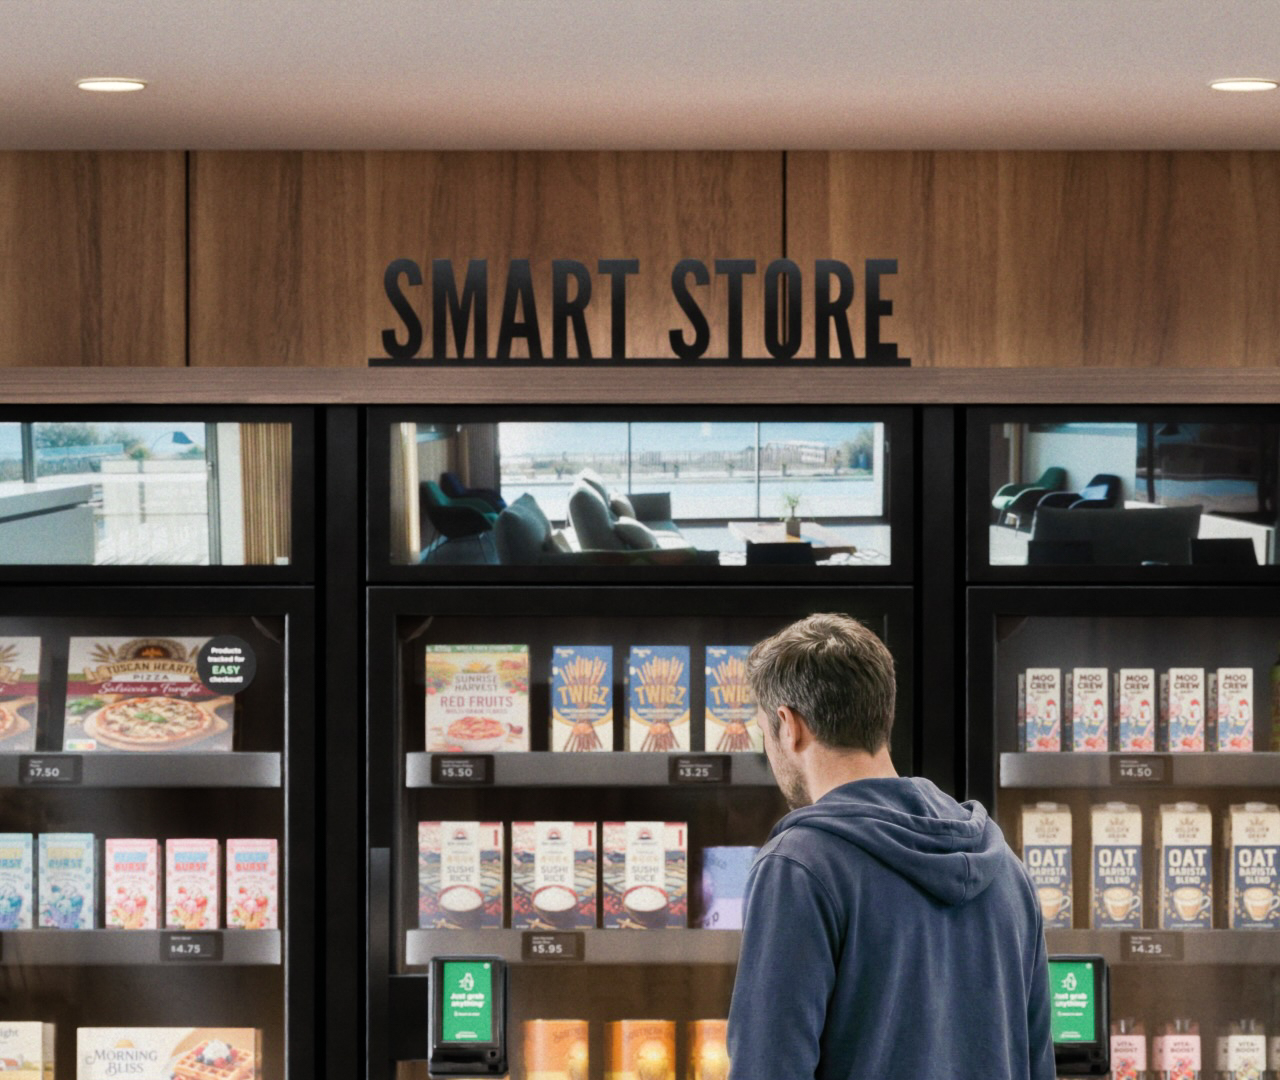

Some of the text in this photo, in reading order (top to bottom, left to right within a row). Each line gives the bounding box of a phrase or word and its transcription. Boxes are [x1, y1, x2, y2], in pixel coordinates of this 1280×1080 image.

[381, 258, 899, 360] SMART STORE
[106, 661, 151, 675] TUSCAN
[211, 665, 241, 675] EASY
[132, 673, 169, 681] PIZZA
[1032, 674, 1054, 682] MOO
[1079, 674, 1101, 682] MOO
[1126, 675, 1148, 683] MOO
[1176, 674, 1198, 682] MOO
[1224, 674, 1246, 682] MOO
[558, 685, 610, 705] TWIGZ
[634, 685, 687, 705] TWIGZ
[710, 685, 751, 705] TWIG
[440, 695, 513, 708] RED FRUITS
[30, 767, 60, 777] $7.50
[442, 767, 473, 777] $5.50
[679, 767, 709, 777] $3.25
[1120, 767, 1152, 777] $4.50
[1028, 848, 1068, 867] OAT
[1098, 848, 1137, 867] OAT
[1168, 848, 1208, 867] OAT
[1238, 848, 1277, 867] OAT
[1099, 867, 1137, 876] BARISTA
[1168, 867, 1207, 876] BARISTA
[1238, 867, 1278, 876] BARISTA
[449, 874, 471, 882] RICE
[544, 874, 566, 882] RICE
[634, 874, 656, 882] RICE
[171, 944, 201, 954] $4.75
[532, 944, 563, 954] $5.95
[1131, 944, 1162, 954] $4.25
[85, 1049, 158, 1065] MORNING
[105, 1062, 144, 1076] BLISS
